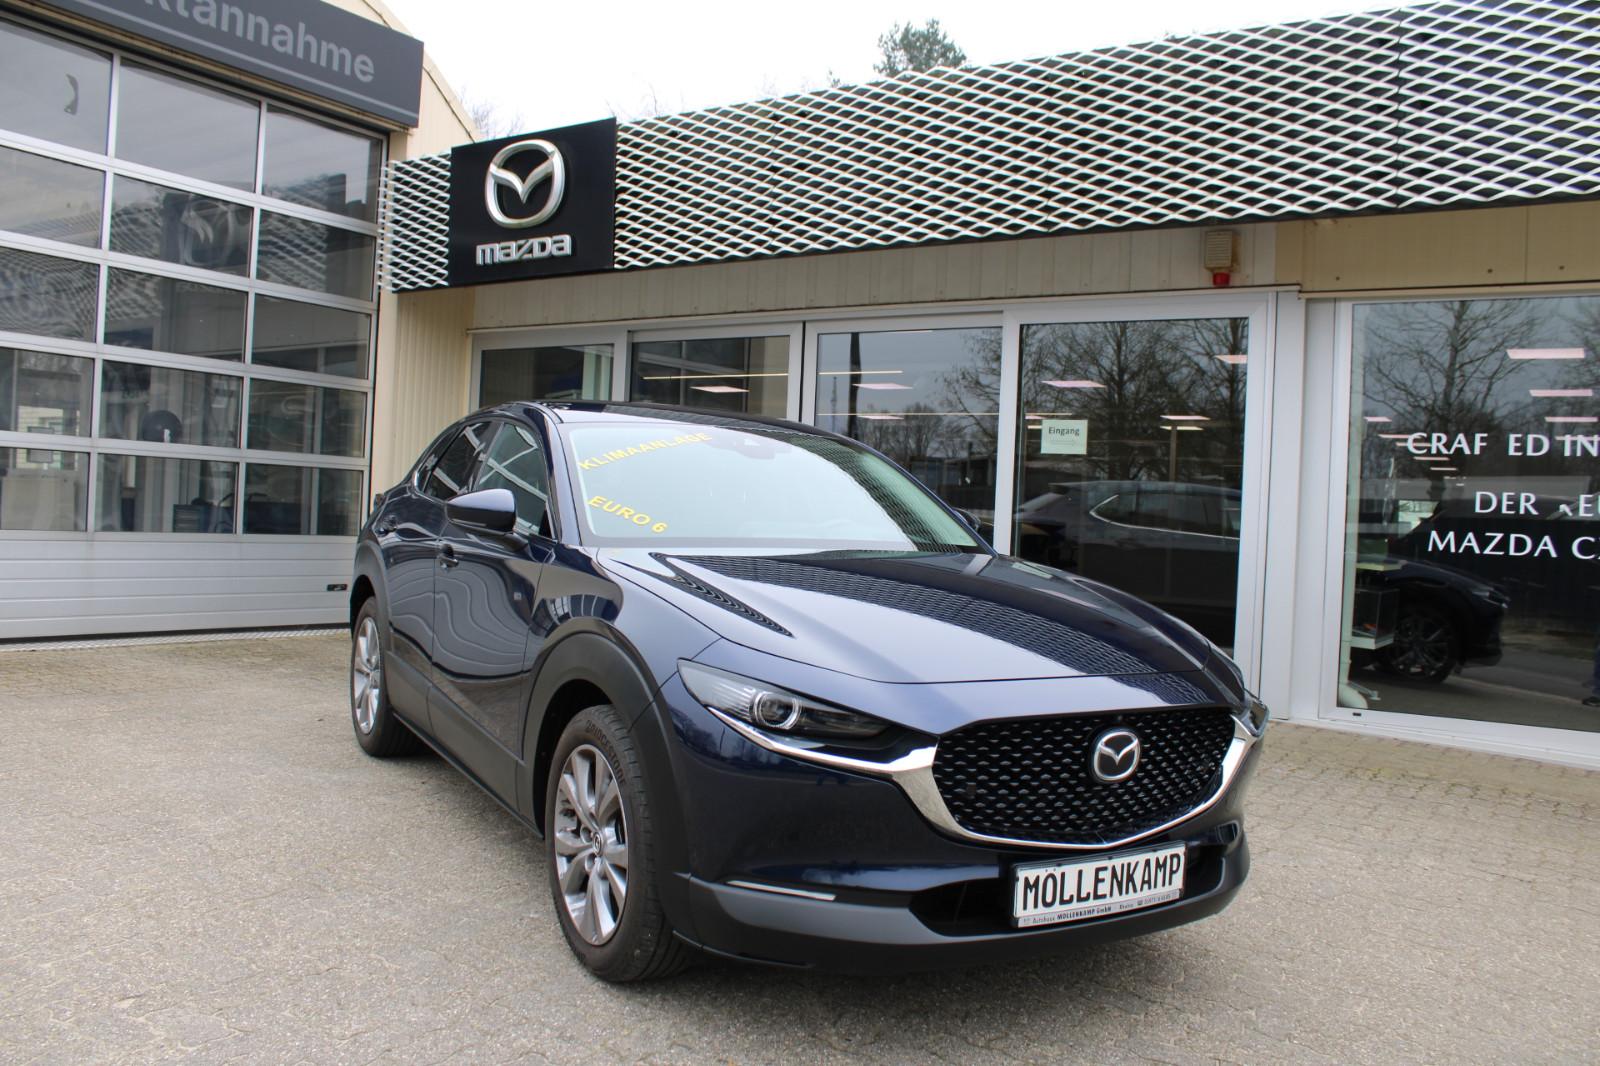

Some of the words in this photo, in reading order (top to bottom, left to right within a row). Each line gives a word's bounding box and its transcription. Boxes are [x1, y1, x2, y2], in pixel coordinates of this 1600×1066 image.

[475, 234, 573, 265] mazda
[1048, 426, 1080, 437] Eingang
[1407, 432, 1550, 456] CRAFED
[577, 432, 713, 470] KLIMAANLAGE
[587, 495, 650, 526] EURO
[652, 522, 668, 533] 6
[1474, 491, 1539, 515] DER
[1427, 530, 1557, 558] MAZDA
[1571, 536, 1600, 560] C
[1022, 853, 1181, 912] MÖLLENKAMP
